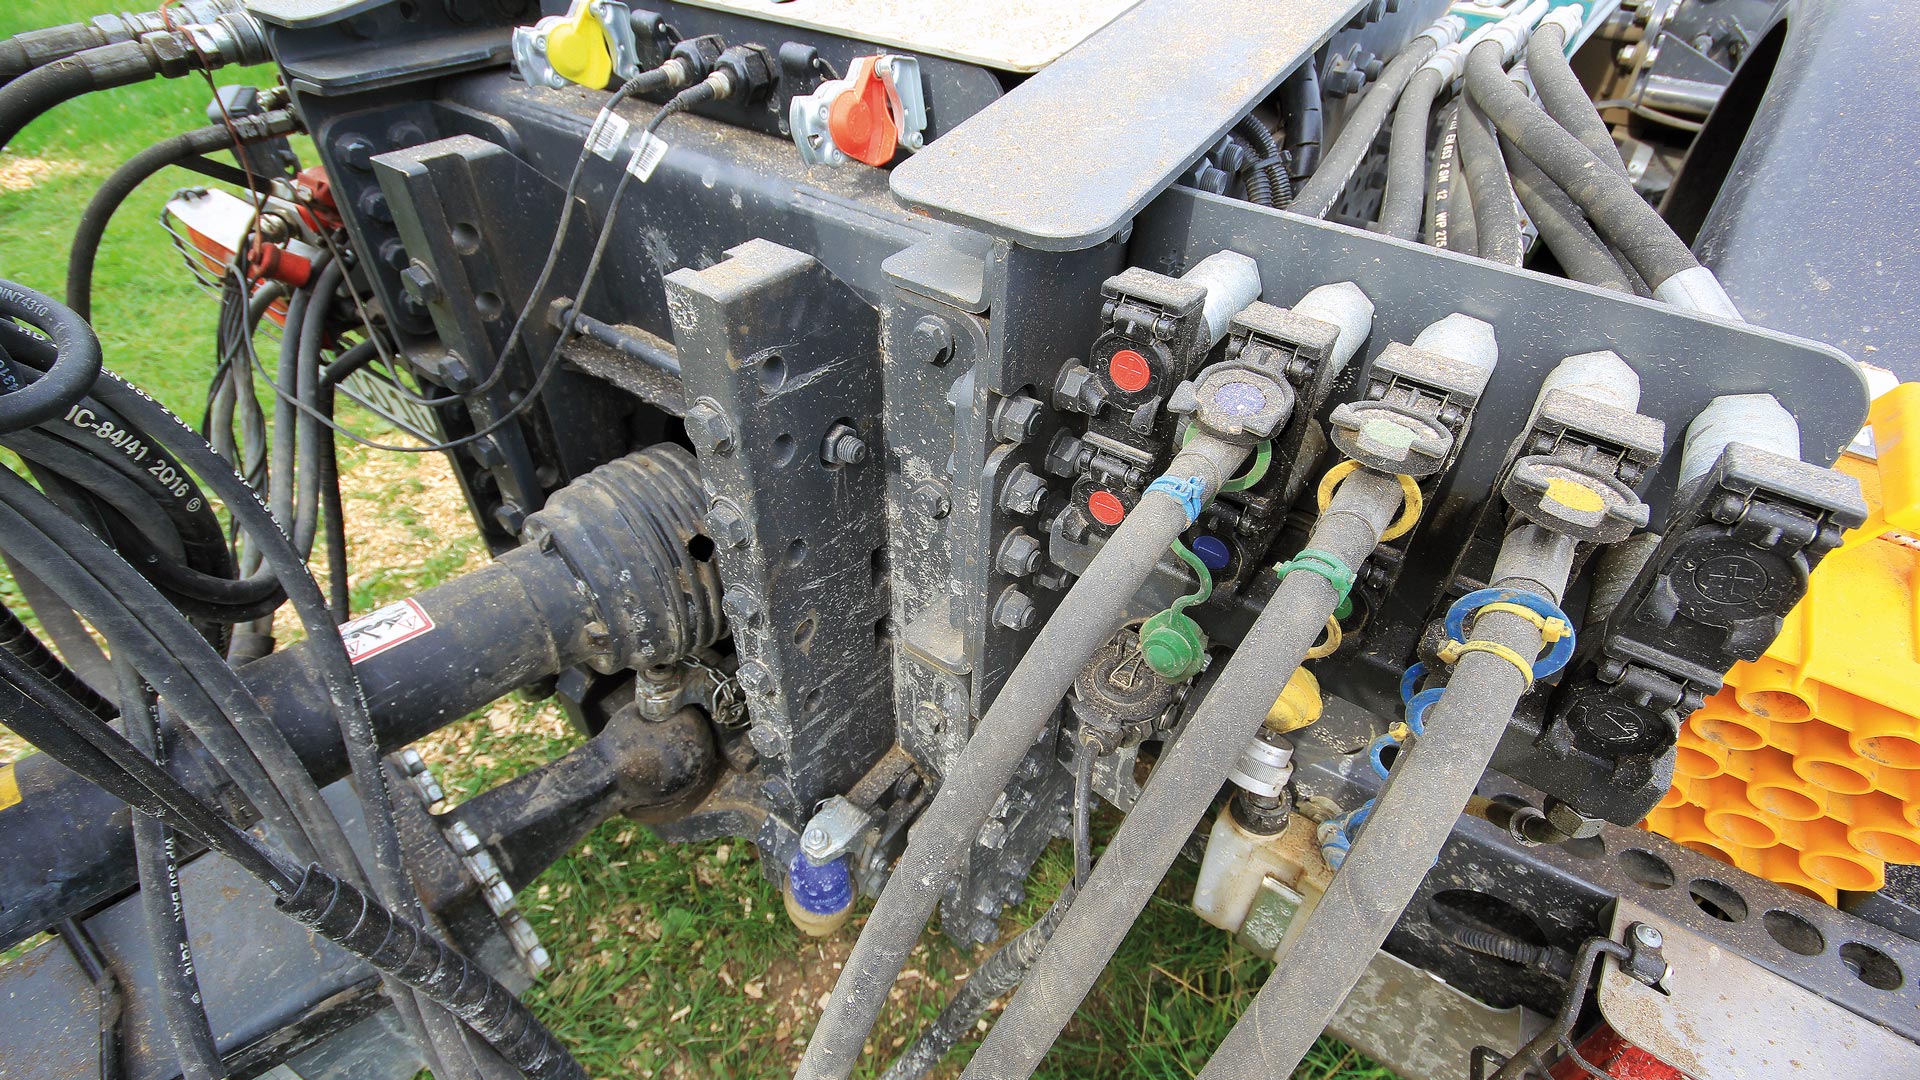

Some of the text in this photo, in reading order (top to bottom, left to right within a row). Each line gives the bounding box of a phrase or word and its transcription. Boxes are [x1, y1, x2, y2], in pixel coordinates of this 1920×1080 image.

[1435, 212, 1448, 228] WP
[1435, 231, 1448, 248] 275
[64, 404, 149, 462] IC-84/41
[148, 459, 190, 498] 2Q16
[164, 837, 176, 860] WP
